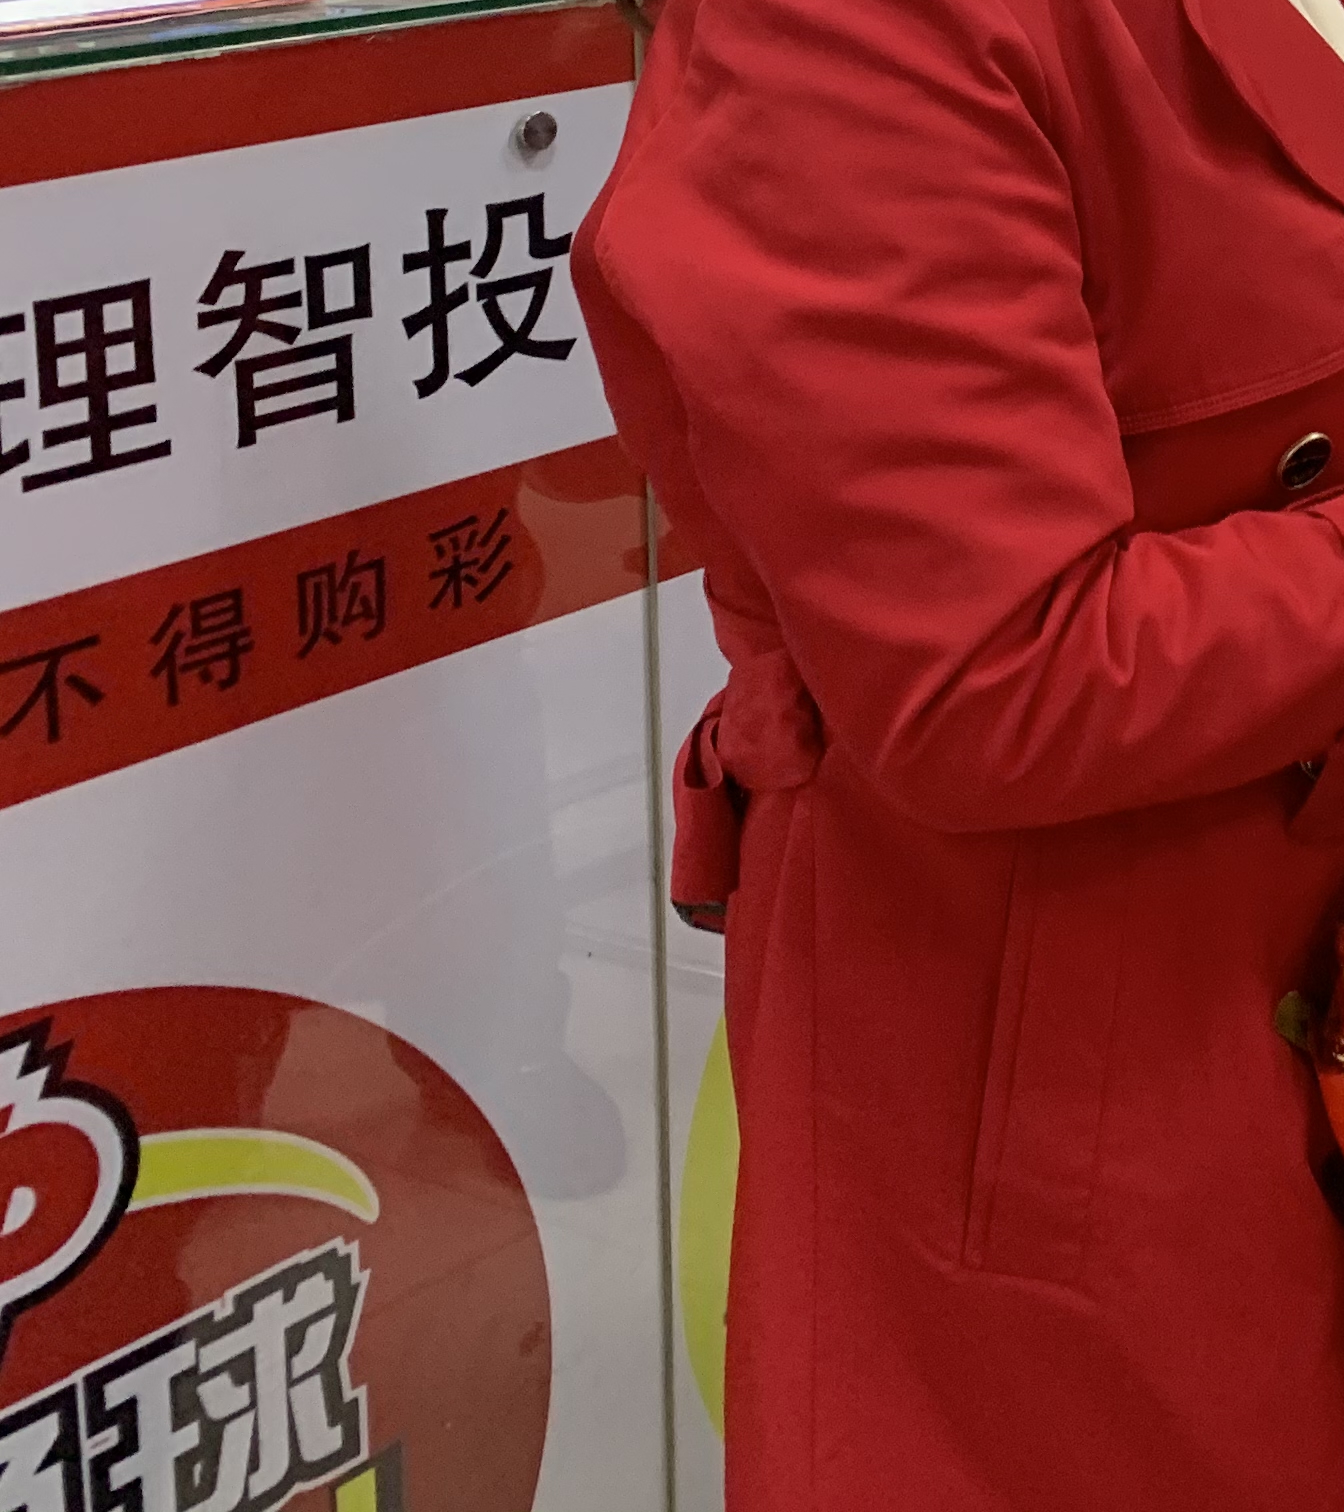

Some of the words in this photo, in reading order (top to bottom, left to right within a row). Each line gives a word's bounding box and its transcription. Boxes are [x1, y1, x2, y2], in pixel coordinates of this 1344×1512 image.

[0, 191, 578, 494] 理智投
[0, 507, 515, 746] 不得购彩
[0, 1243, 370, 1512] 球
